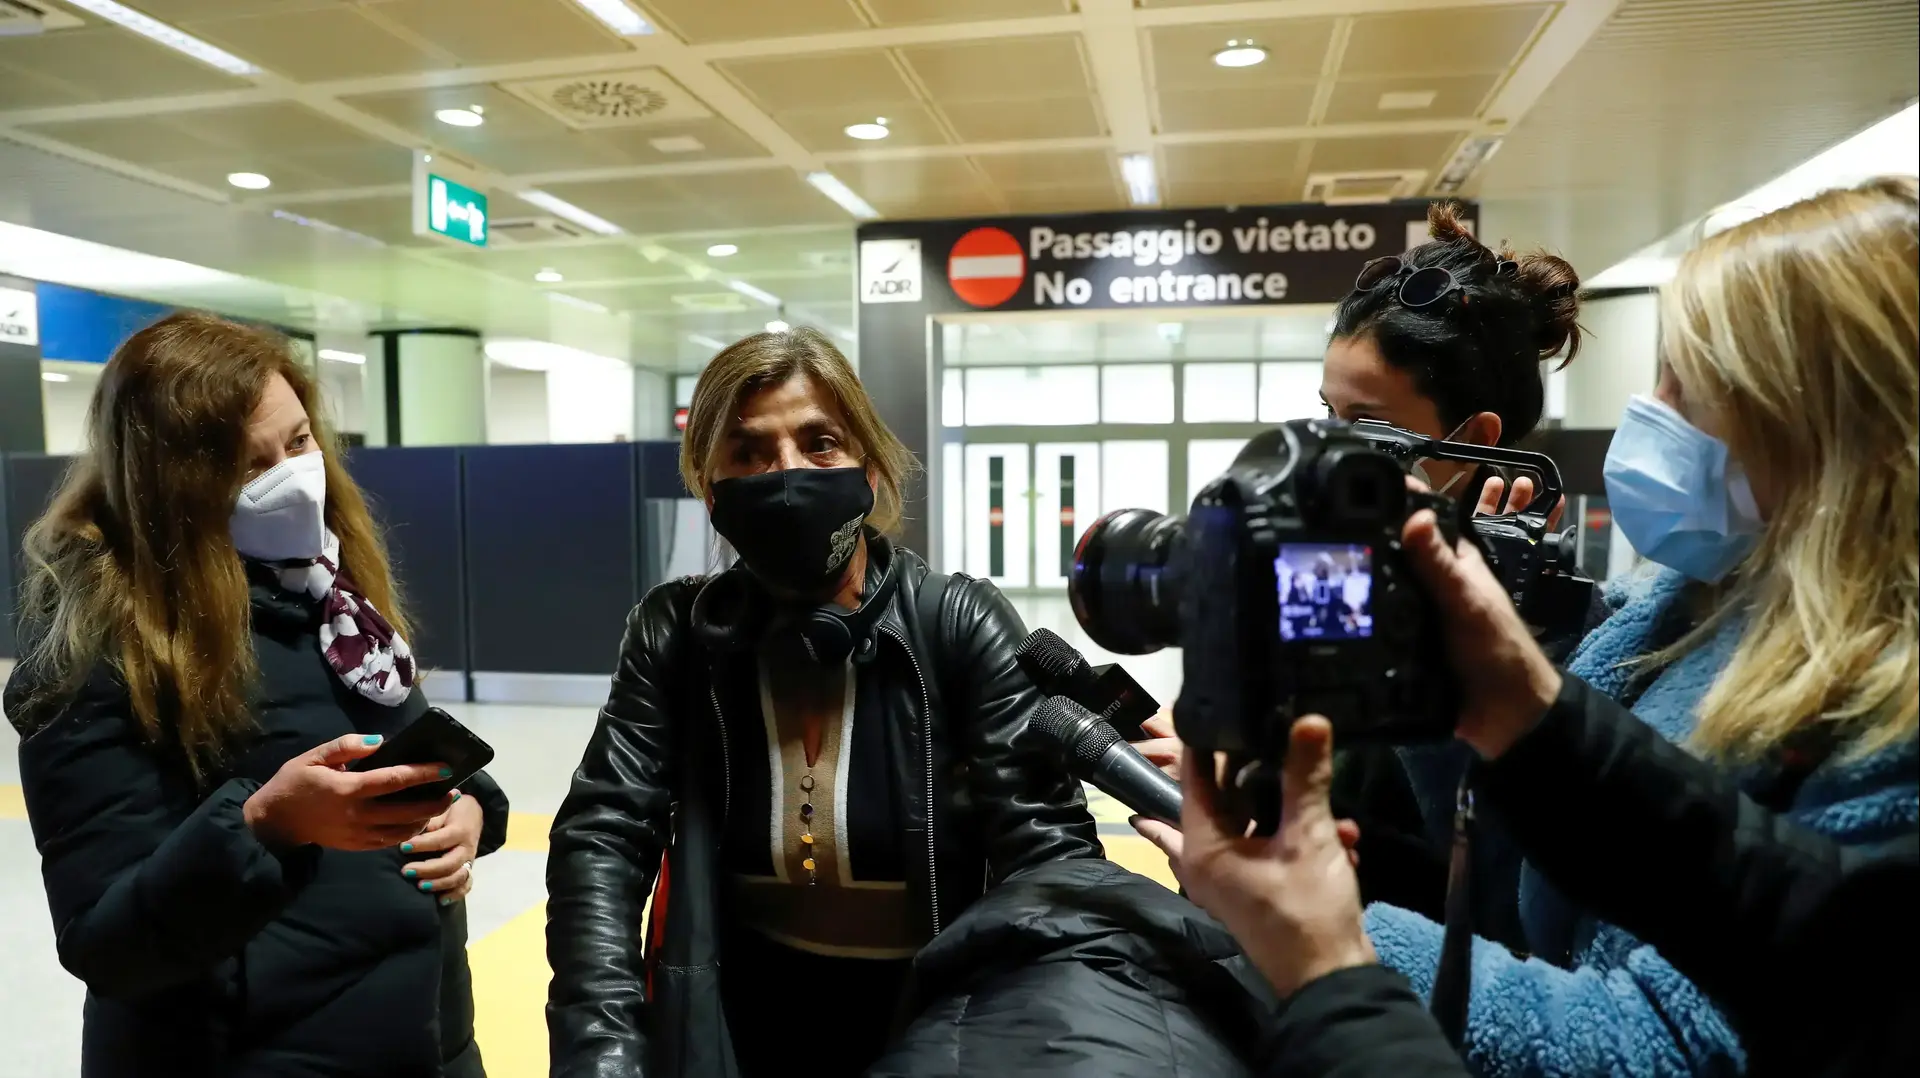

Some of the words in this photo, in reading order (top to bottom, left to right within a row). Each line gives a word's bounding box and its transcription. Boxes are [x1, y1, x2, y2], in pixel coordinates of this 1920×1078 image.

[1030, 220, 1222, 266] Passaggio
[1233, 218, 1376, 252] vietato
[869, 279, 913, 295] ADR
[1034, 271, 1092, 304] No
[1110, 270, 1288, 302] entrance
